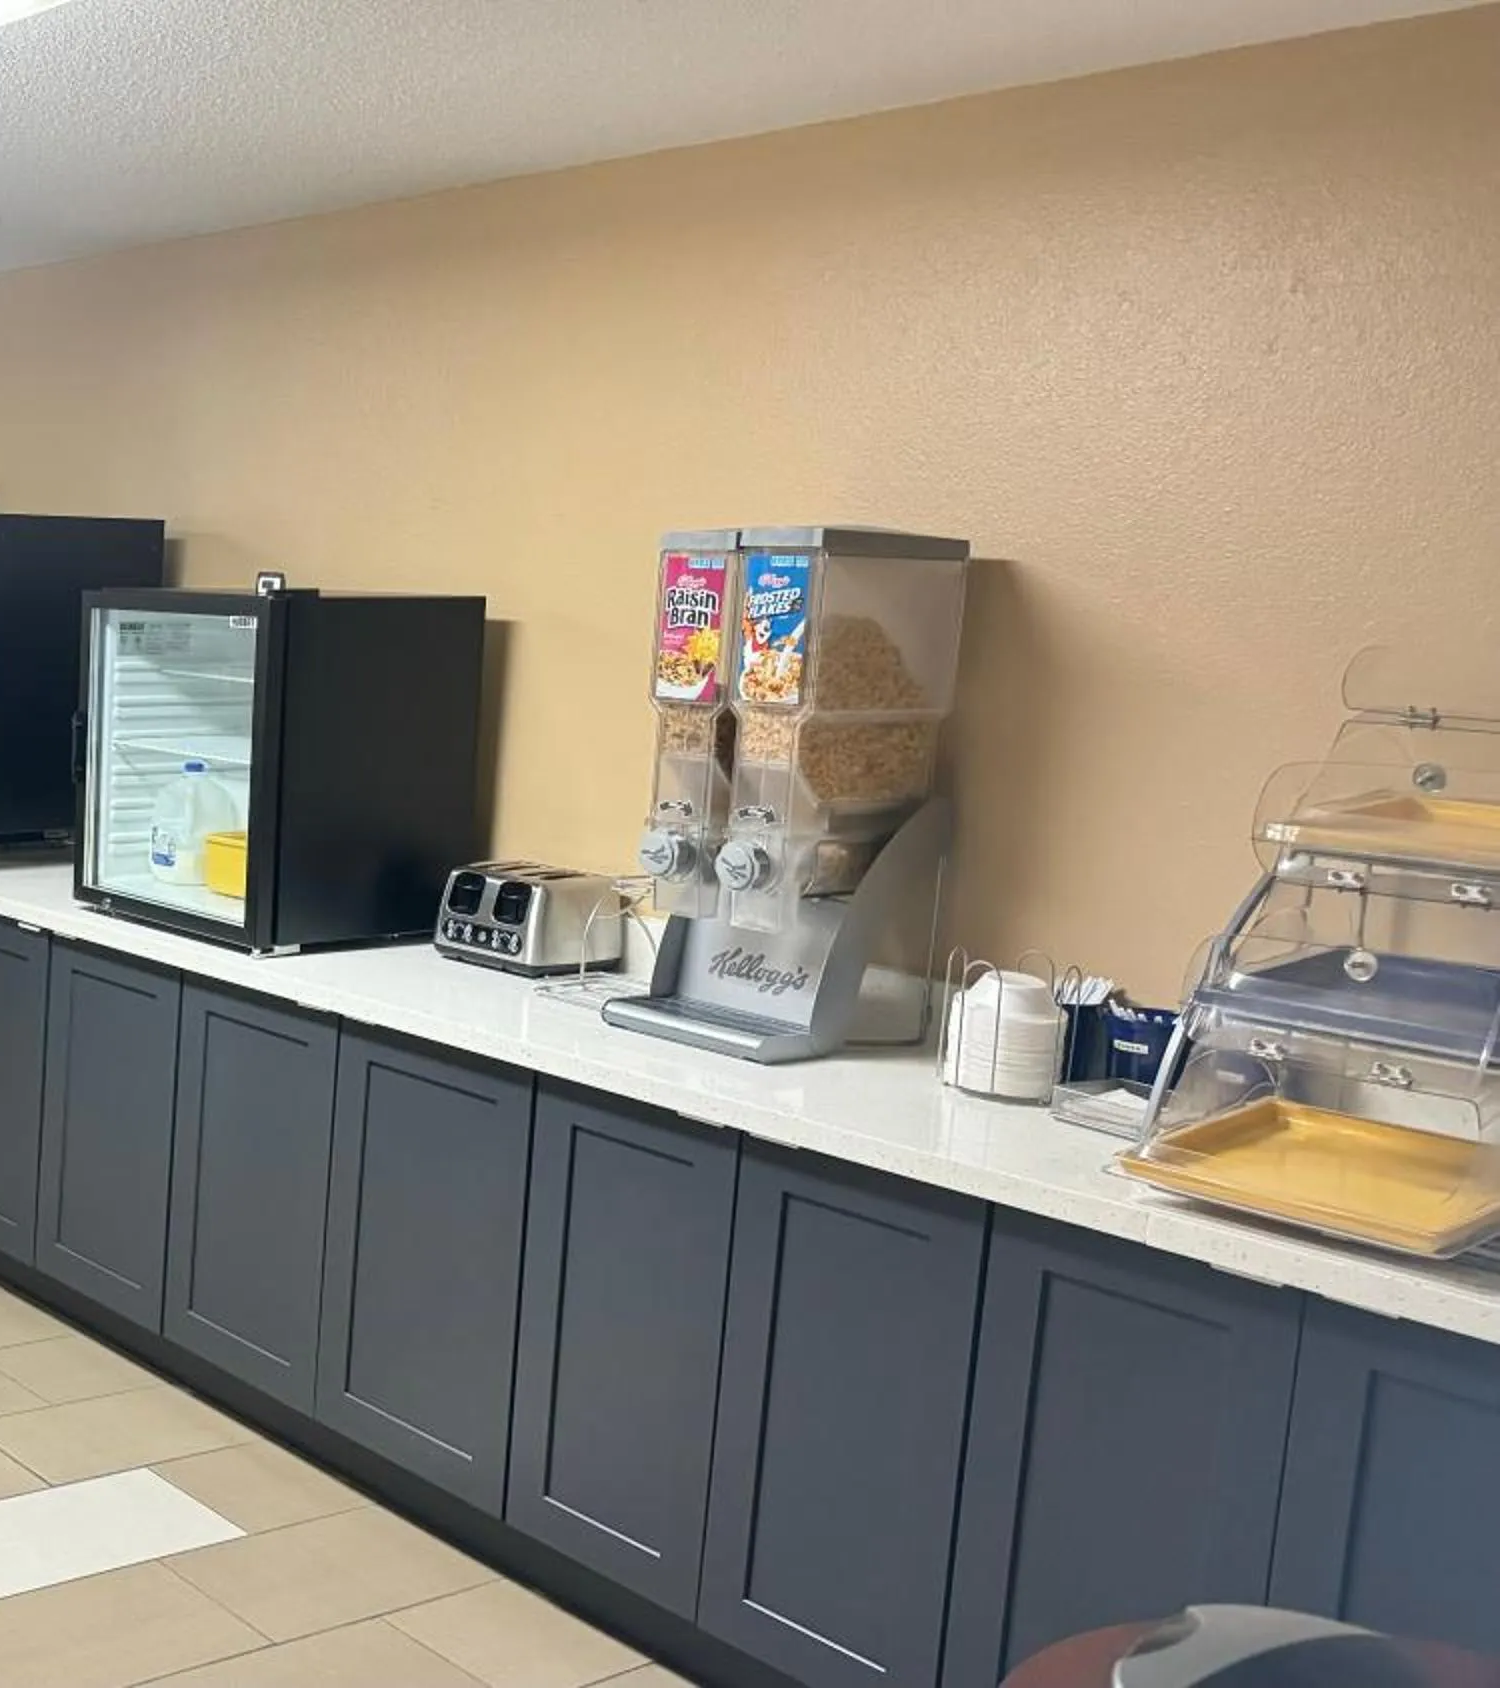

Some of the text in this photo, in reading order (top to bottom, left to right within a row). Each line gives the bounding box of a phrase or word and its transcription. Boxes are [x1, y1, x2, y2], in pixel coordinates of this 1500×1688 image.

[667, 588, 718, 611] Raisin
[750, 587, 801, 605] FROSTED
[669, 608, 711, 628] Bran
[749, 602, 791, 619] FLAKES
[708, 946, 809, 996] Kellogg's
